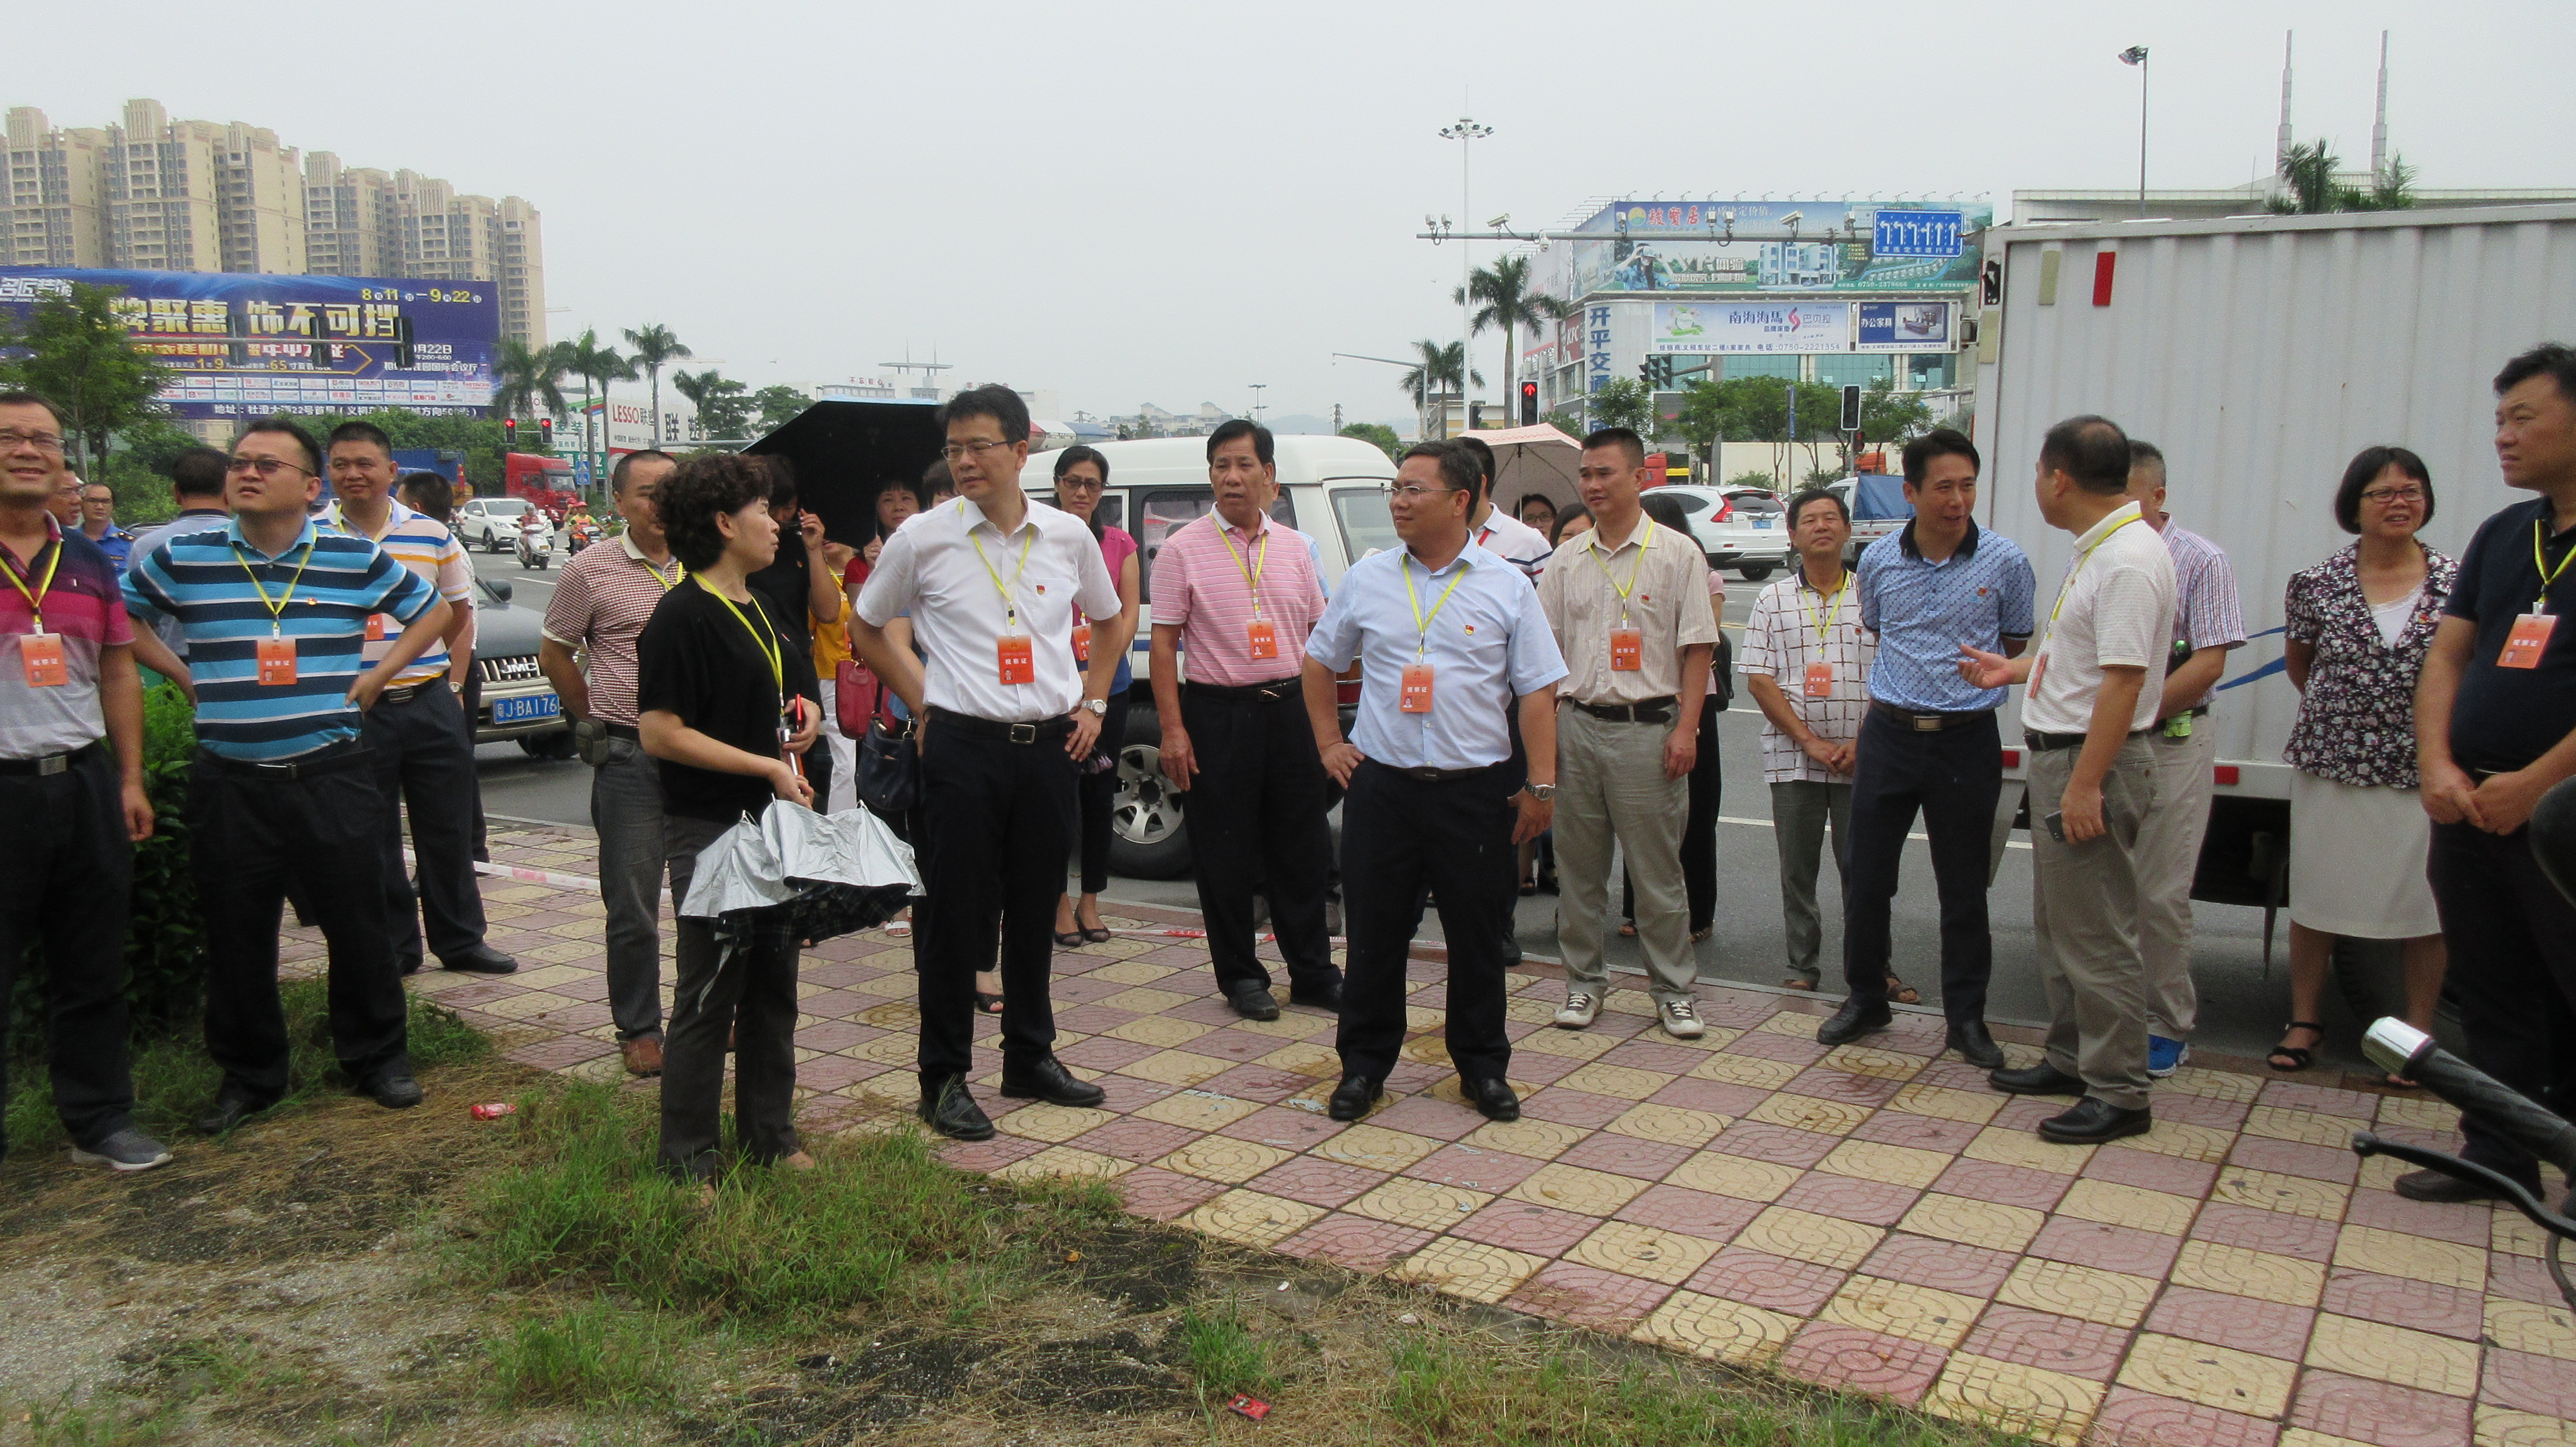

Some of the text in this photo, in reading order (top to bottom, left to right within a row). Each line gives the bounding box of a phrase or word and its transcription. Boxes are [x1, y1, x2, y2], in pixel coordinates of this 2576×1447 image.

[99, 297, 229, 333] 牌聚惠
[1861, 318, 1893, 328] 办公家具
[1566, 325, 1579, 345] KFC
[384, 362, 478, 372] 相桂园国际会议厅
[612, 404, 639, 424] LESSO
[501, 662, 537, 674] JMC
